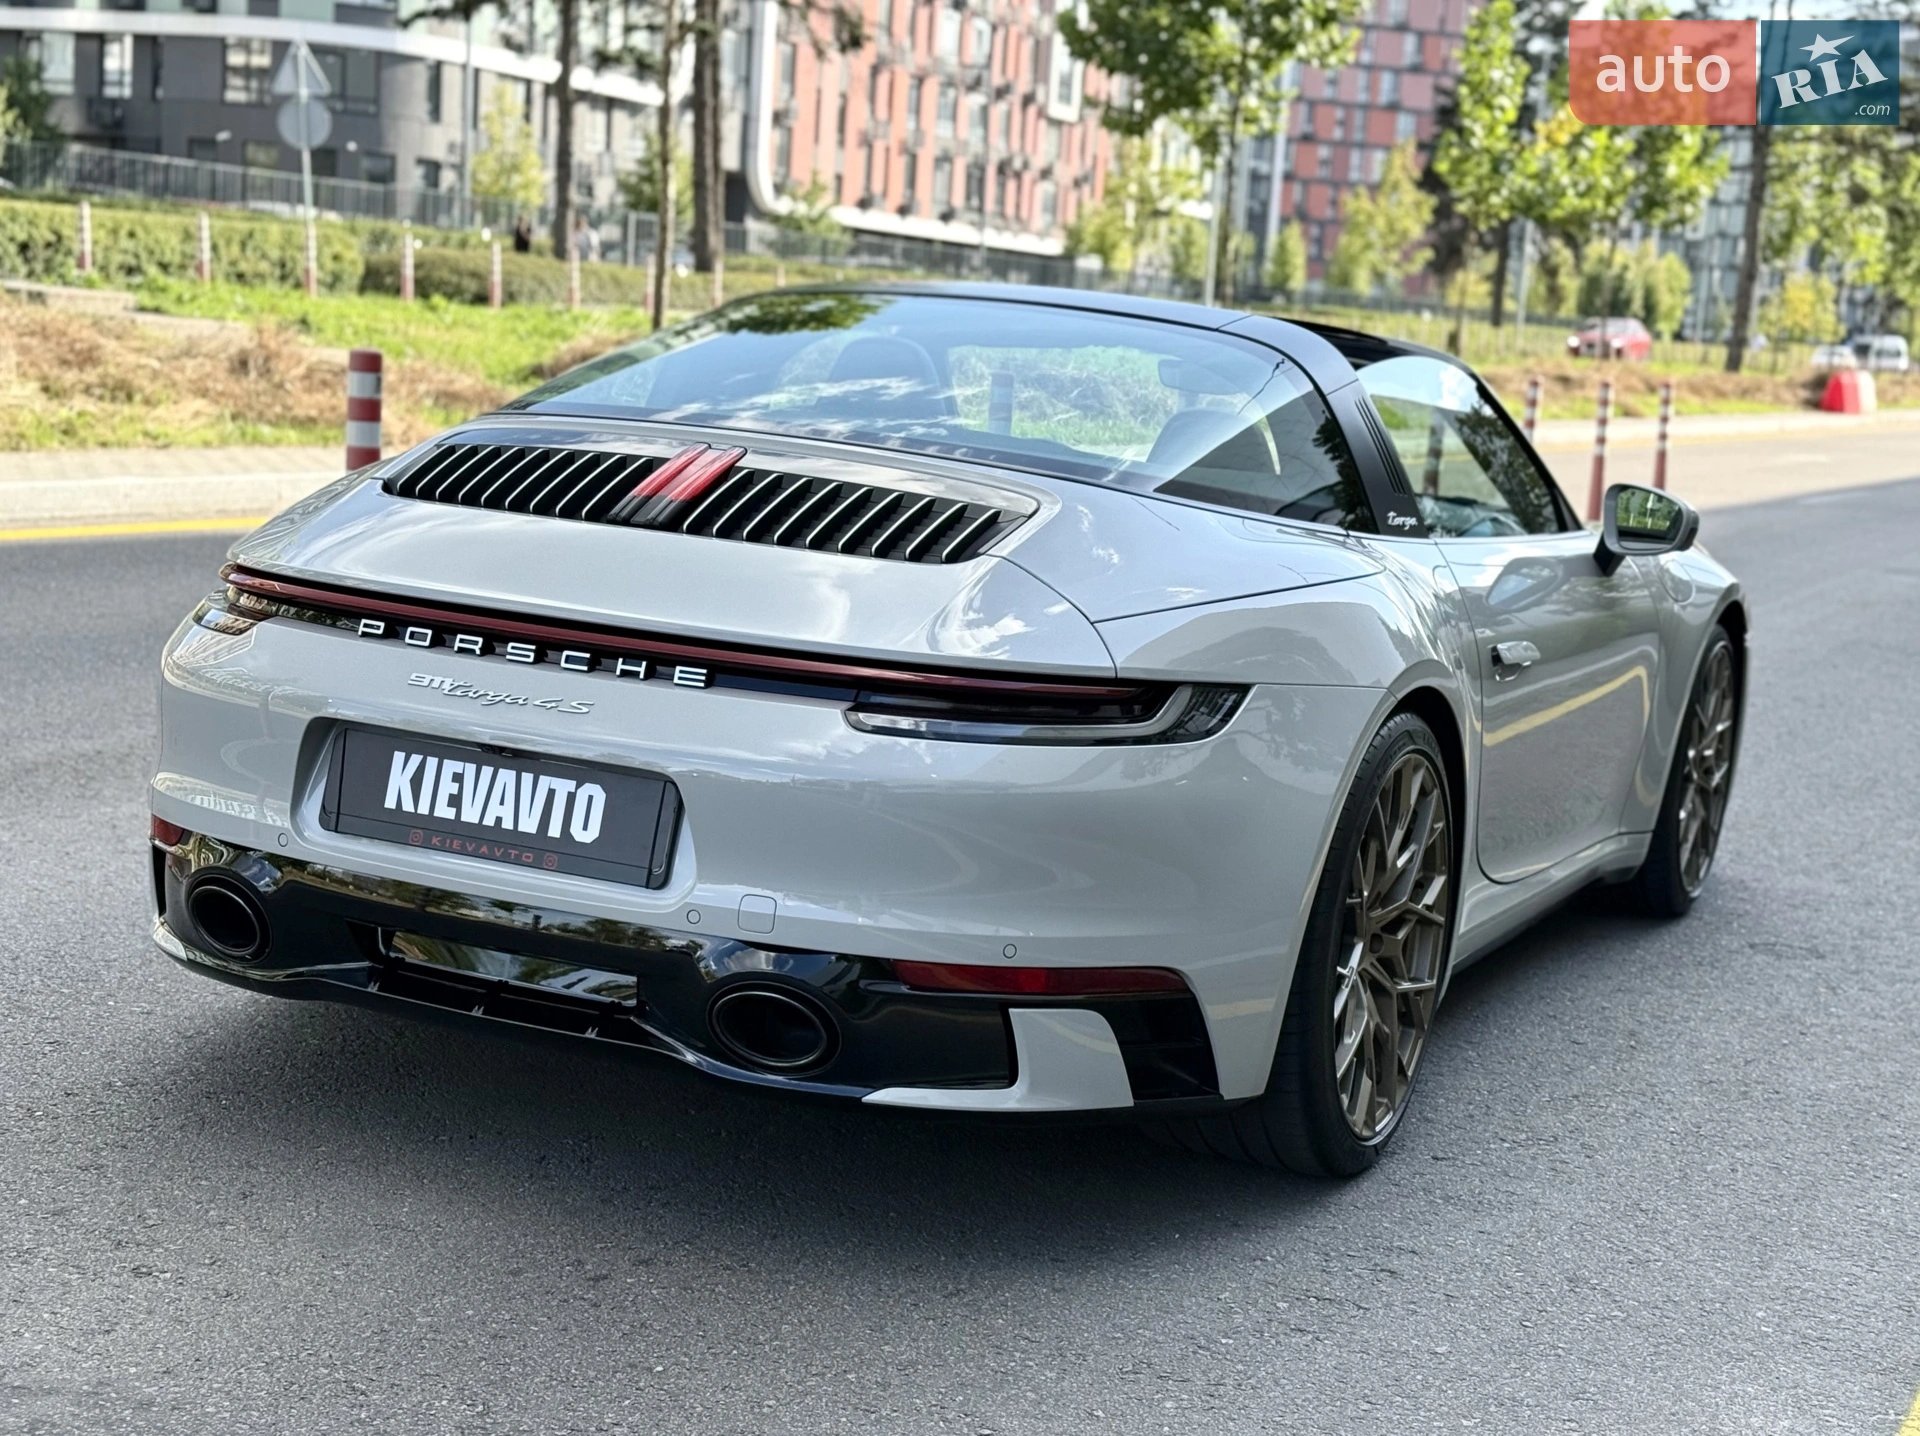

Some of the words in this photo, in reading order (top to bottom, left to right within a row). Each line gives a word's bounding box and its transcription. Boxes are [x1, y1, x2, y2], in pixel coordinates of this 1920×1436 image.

[358, 618, 708, 688] PORSCHE
[384, 750, 607, 844] KIEVAVTO
[431, 835, 534, 863] KIEVAVTO
